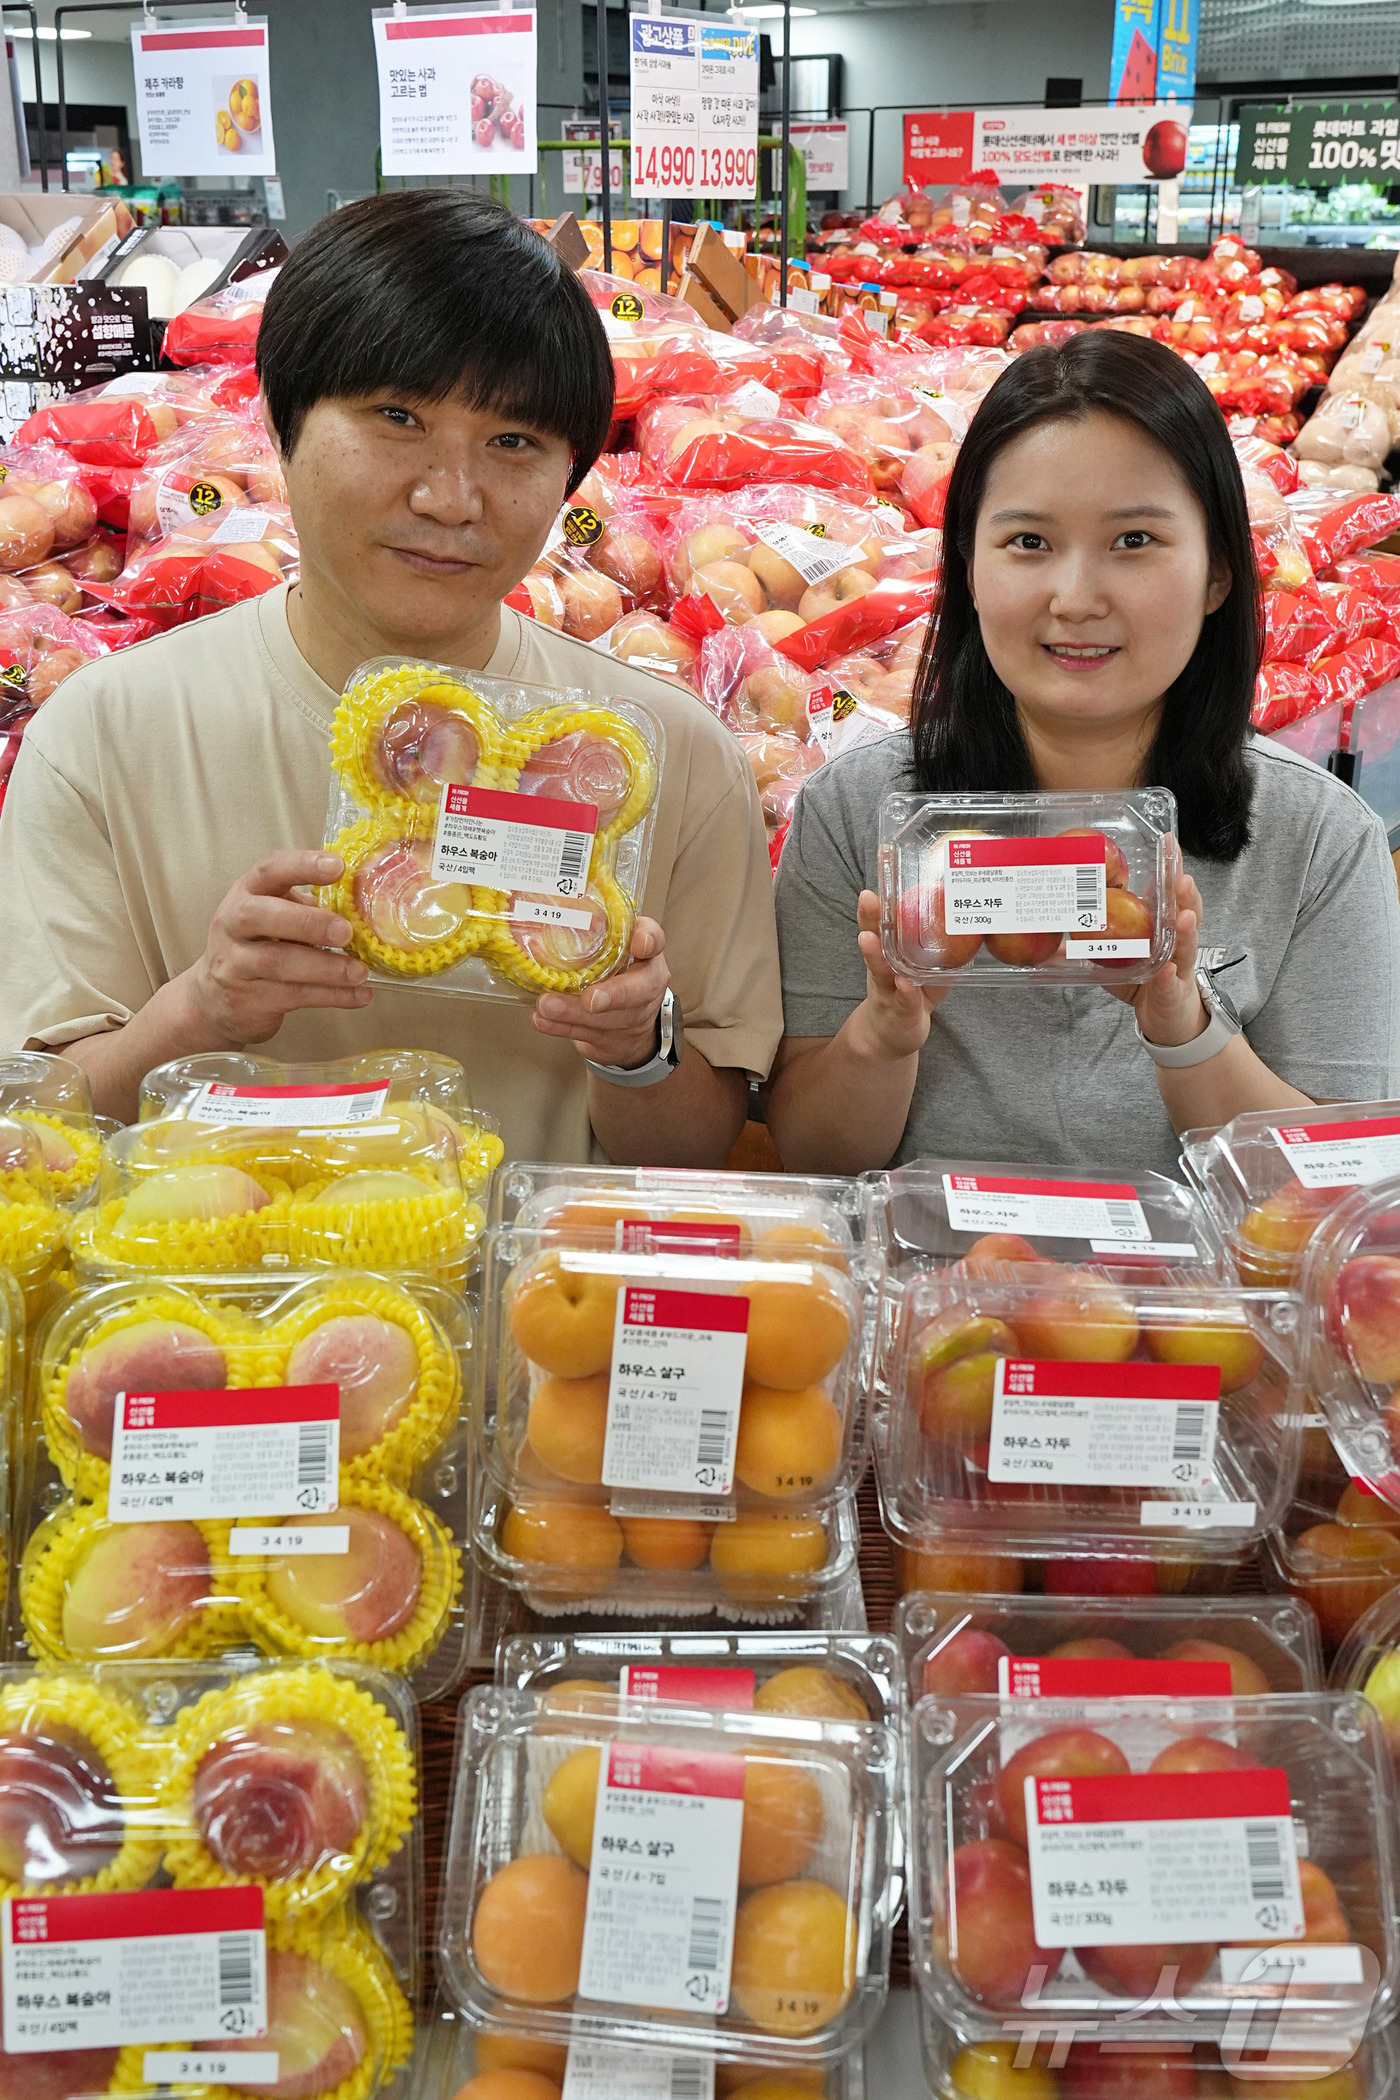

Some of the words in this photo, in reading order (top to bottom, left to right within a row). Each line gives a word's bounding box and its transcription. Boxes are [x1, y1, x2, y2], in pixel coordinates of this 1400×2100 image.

[1162, 43, 1187, 74] Brix
[389, 69, 416, 83] 맛있는
[418, 68, 436, 81] 사과
[145, 78, 160, 90] 제주
[161, 77, 184, 89] 카라향
[391, 85, 416, 98] 고르는
[419, 84, 427, 98] 법
[702, 97, 712, 110] 정말
[721, 98, 731, 110] 따온
[733, 99, 743, 109] 사과
[636, 109, 649, 123] 사각
[683, 111, 695, 123] 사과
[713, 116, 731, 127] CA저장
[1313, 120, 1366, 138] 롯데마트
[1369, 119, 1399, 137] 과일
[1057, 133, 1065, 146] 세
[1068, 133, 1076, 146] 번
[1079, 133, 1098, 146] 이상
[1253, 137, 1289, 154] 신선을
[982, 150, 1011, 163] 100%
[1308, 140, 1378, 169] 100%
[635, 146, 695, 186] 14,990
[700, 148, 756, 189] 13,990
[1251, 154, 1288, 170] 새롭게
[584, 166, 621, 188] 7,90
[616, 301, 636, 315] 12
[92, 323, 135, 340] 설향메론
[194, 488, 215, 505] 12
[573, 510, 597, 538] 12
[450, 796, 468, 805] 신선을
[441, 844, 468, 858] 하우스
[469, 848, 498, 862] 복숭아
[953, 898, 982, 909] 하우스
[984, 898, 1003, 909] 자두
[534, 908, 540, 916] 3
[542, 909, 549, 917] 4
[551, 910, 562, 919] 19
[1088, 944, 1095, 952] 3
[1097, 944, 1103, 952] 4
[1106, 944, 1118, 952] 19
[960, 1208, 993, 1216] 하우스
[618, 1363, 657, 1378] 하우스
[660, 1364, 686, 1380] 살구
[1003, 1437, 1042, 1449] 하우스
[1045, 1438, 1071, 1449] 자두
[121, 1472, 161, 1487] 하우스
[165, 1470, 204, 1484] 복숭아
[776, 1477, 783, 1486] 3
[787, 1477, 794, 1486] 4
[800, 1476, 813, 1486] 19
[1172, 1508, 1179, 1516] 3
[1184, 1508, 1191, 1516] 4
[1197, 1508, 1211, 1516] 19
[261, 1536, 269, 1546] 3
[275, 1536, 282, 1545] 4
[288, 1536, 303, 1545] 19
[601, 1836, 643, 1854] 하우스
[646, 1840, 675, 1857] 살구
[1047, 1882, 1095, 1897] 하우스
[1097, 1880, 1129, 1895] 자두
[16, 1993, 62, 2010] 하우스
[65, 1990, 111, 2007] 복숭아
[776, 2000, 783, 2012] 3
[789, 2000, 797, 2012] 4
[804, 2001, 819, 2014] 19
[180, 2062, 188, 2073] 3
[195, 2062, 202, 2073] 4
[209, 2062, 227, 2073] 19
